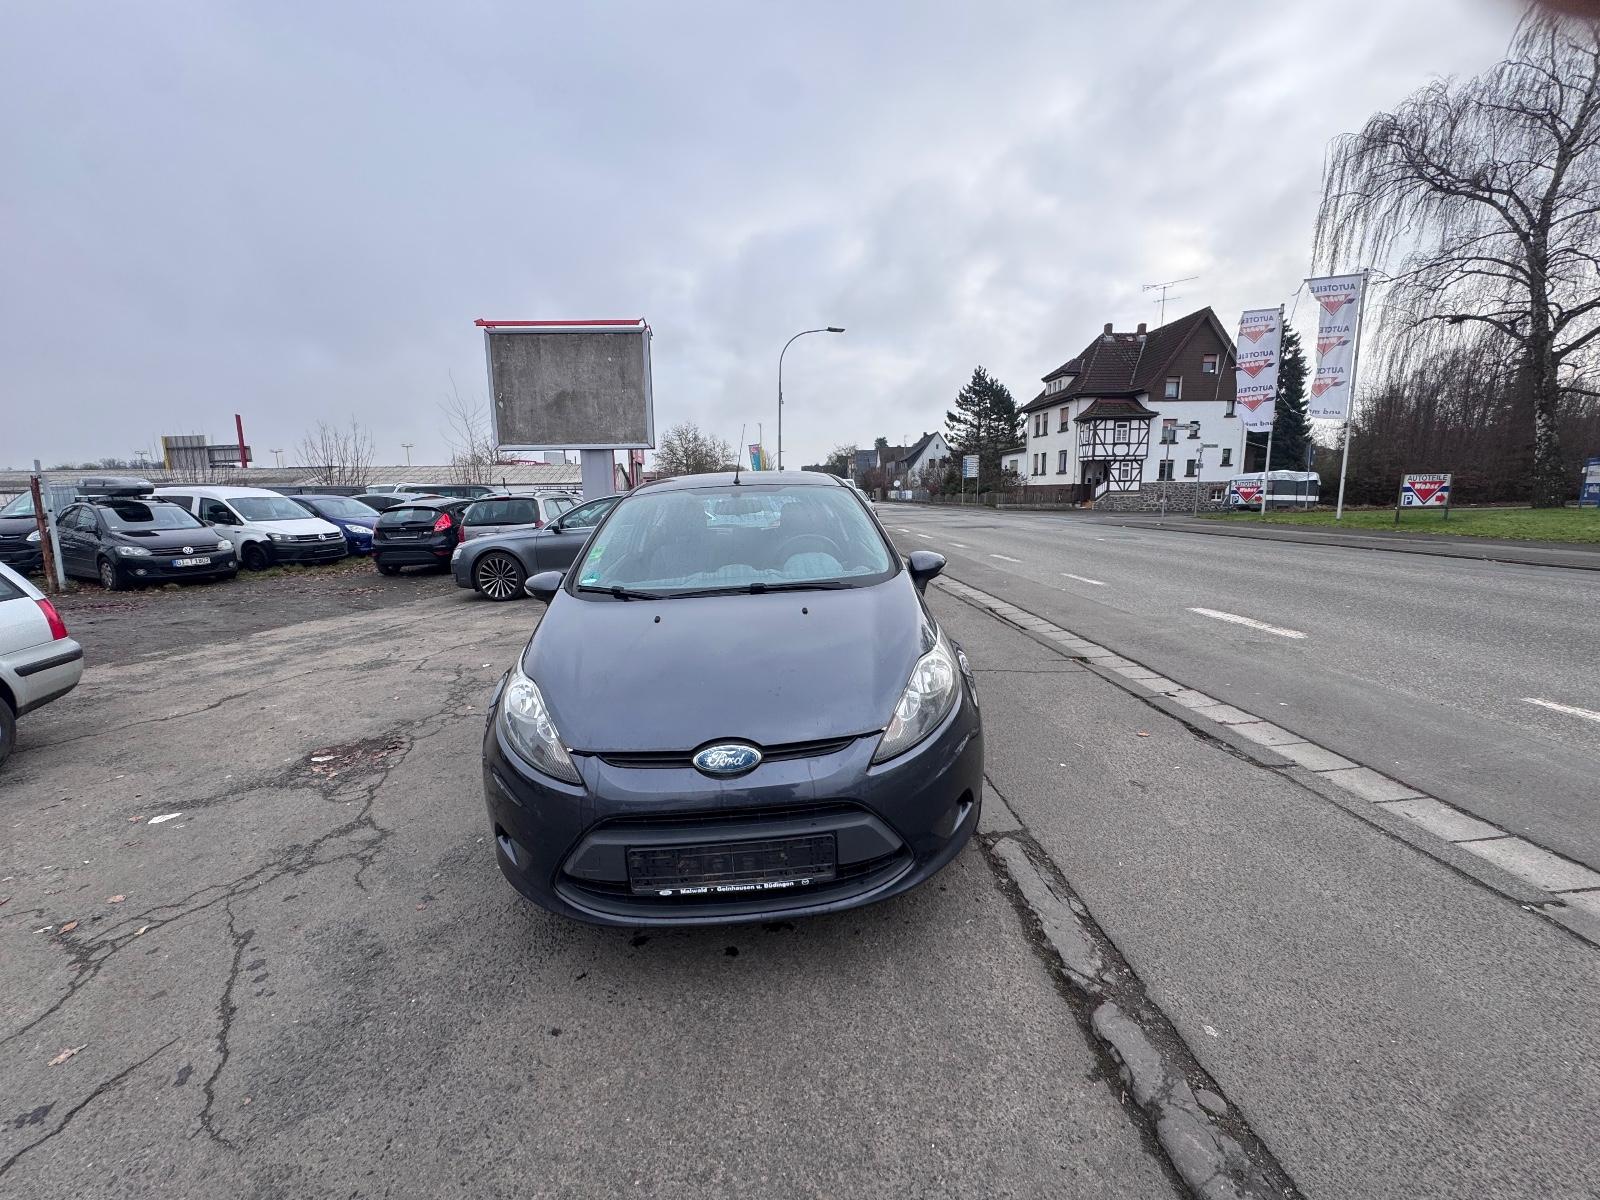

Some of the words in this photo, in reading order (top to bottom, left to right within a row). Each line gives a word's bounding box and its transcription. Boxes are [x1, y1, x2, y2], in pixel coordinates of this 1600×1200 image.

[1407, 474, 1449, 482] AUTOTEILE
[1404, 495, 1413, 505] P
[704, 750, 746, 768] Ford
